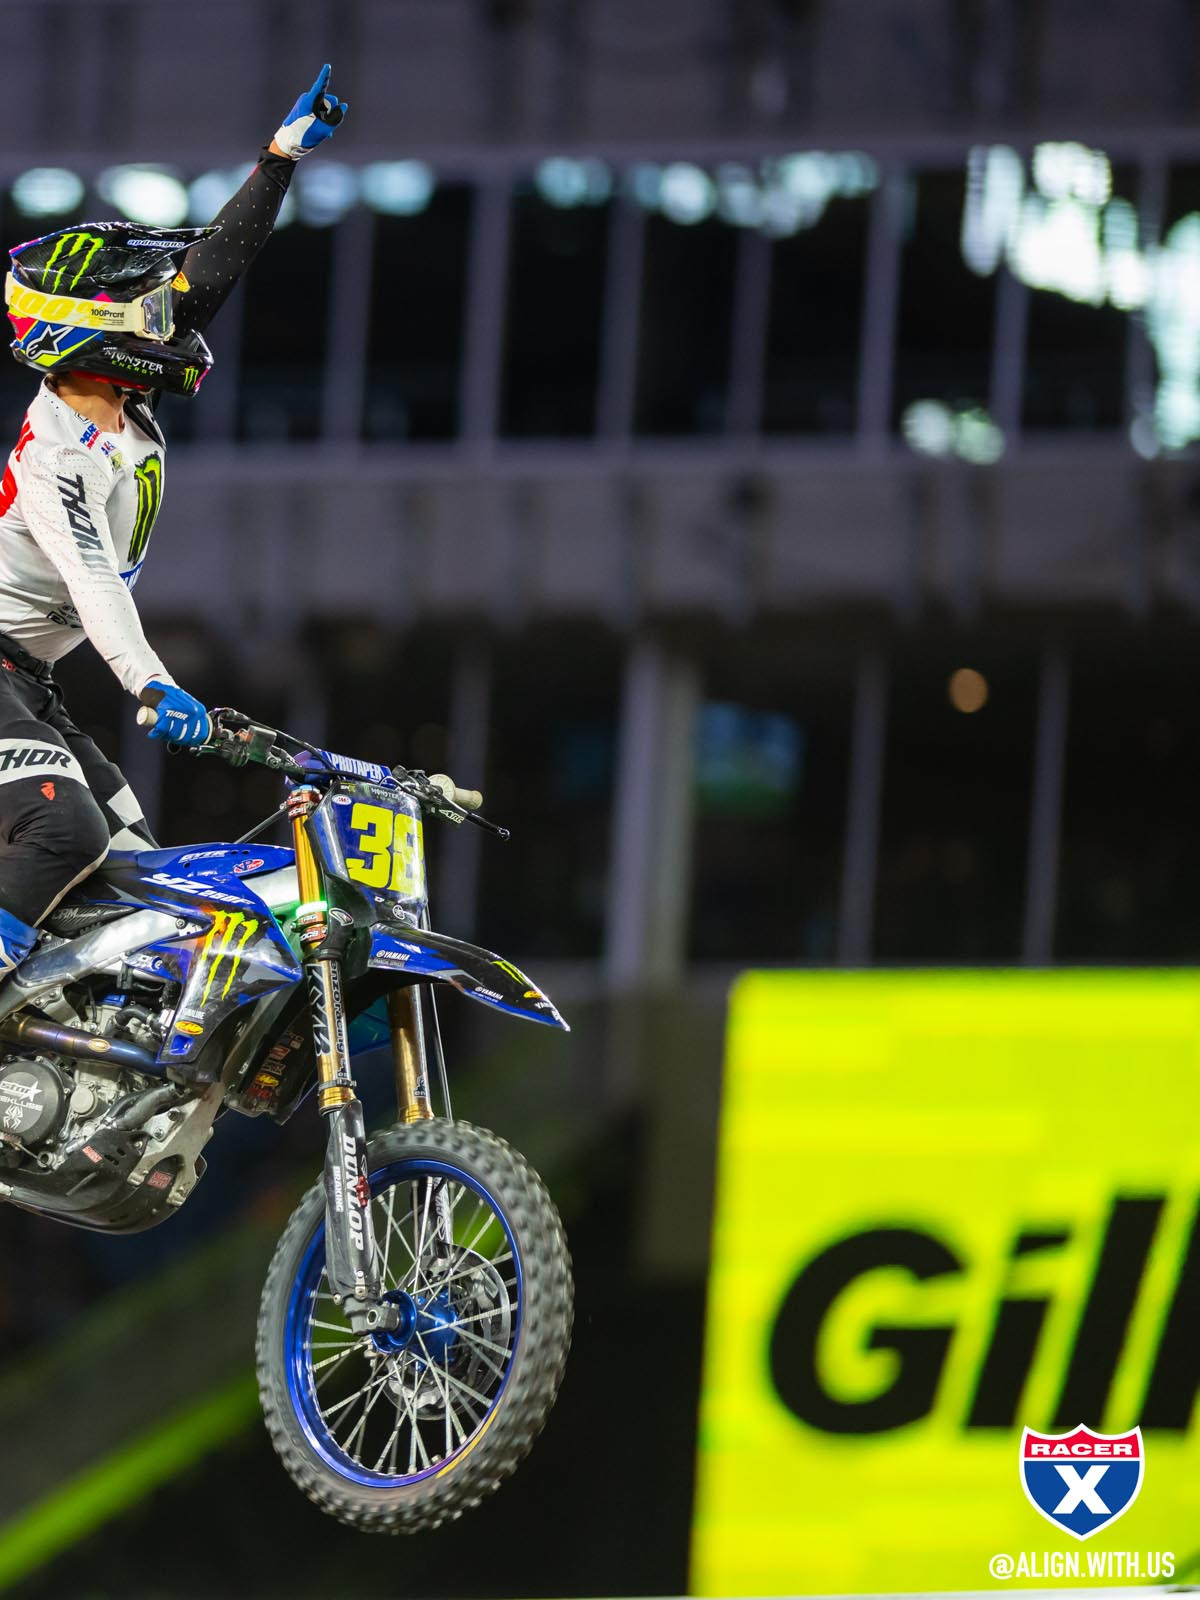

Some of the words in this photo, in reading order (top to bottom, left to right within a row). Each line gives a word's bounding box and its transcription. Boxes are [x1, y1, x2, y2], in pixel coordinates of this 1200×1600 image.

[104, 349, 163, 373] MONSTER
[166, 708, 188, 721] THOR
[332, 754, 386, 780] PROTAPER
[346, 802, 424, 899] 38
[383, 951, 410, 962] YAMAHA
[480, 987, 504, 1001] YAMAHA
[332, 1165, 343, 1213] BRAKING
[343, 1134, 365, 1251] DUNLOP
